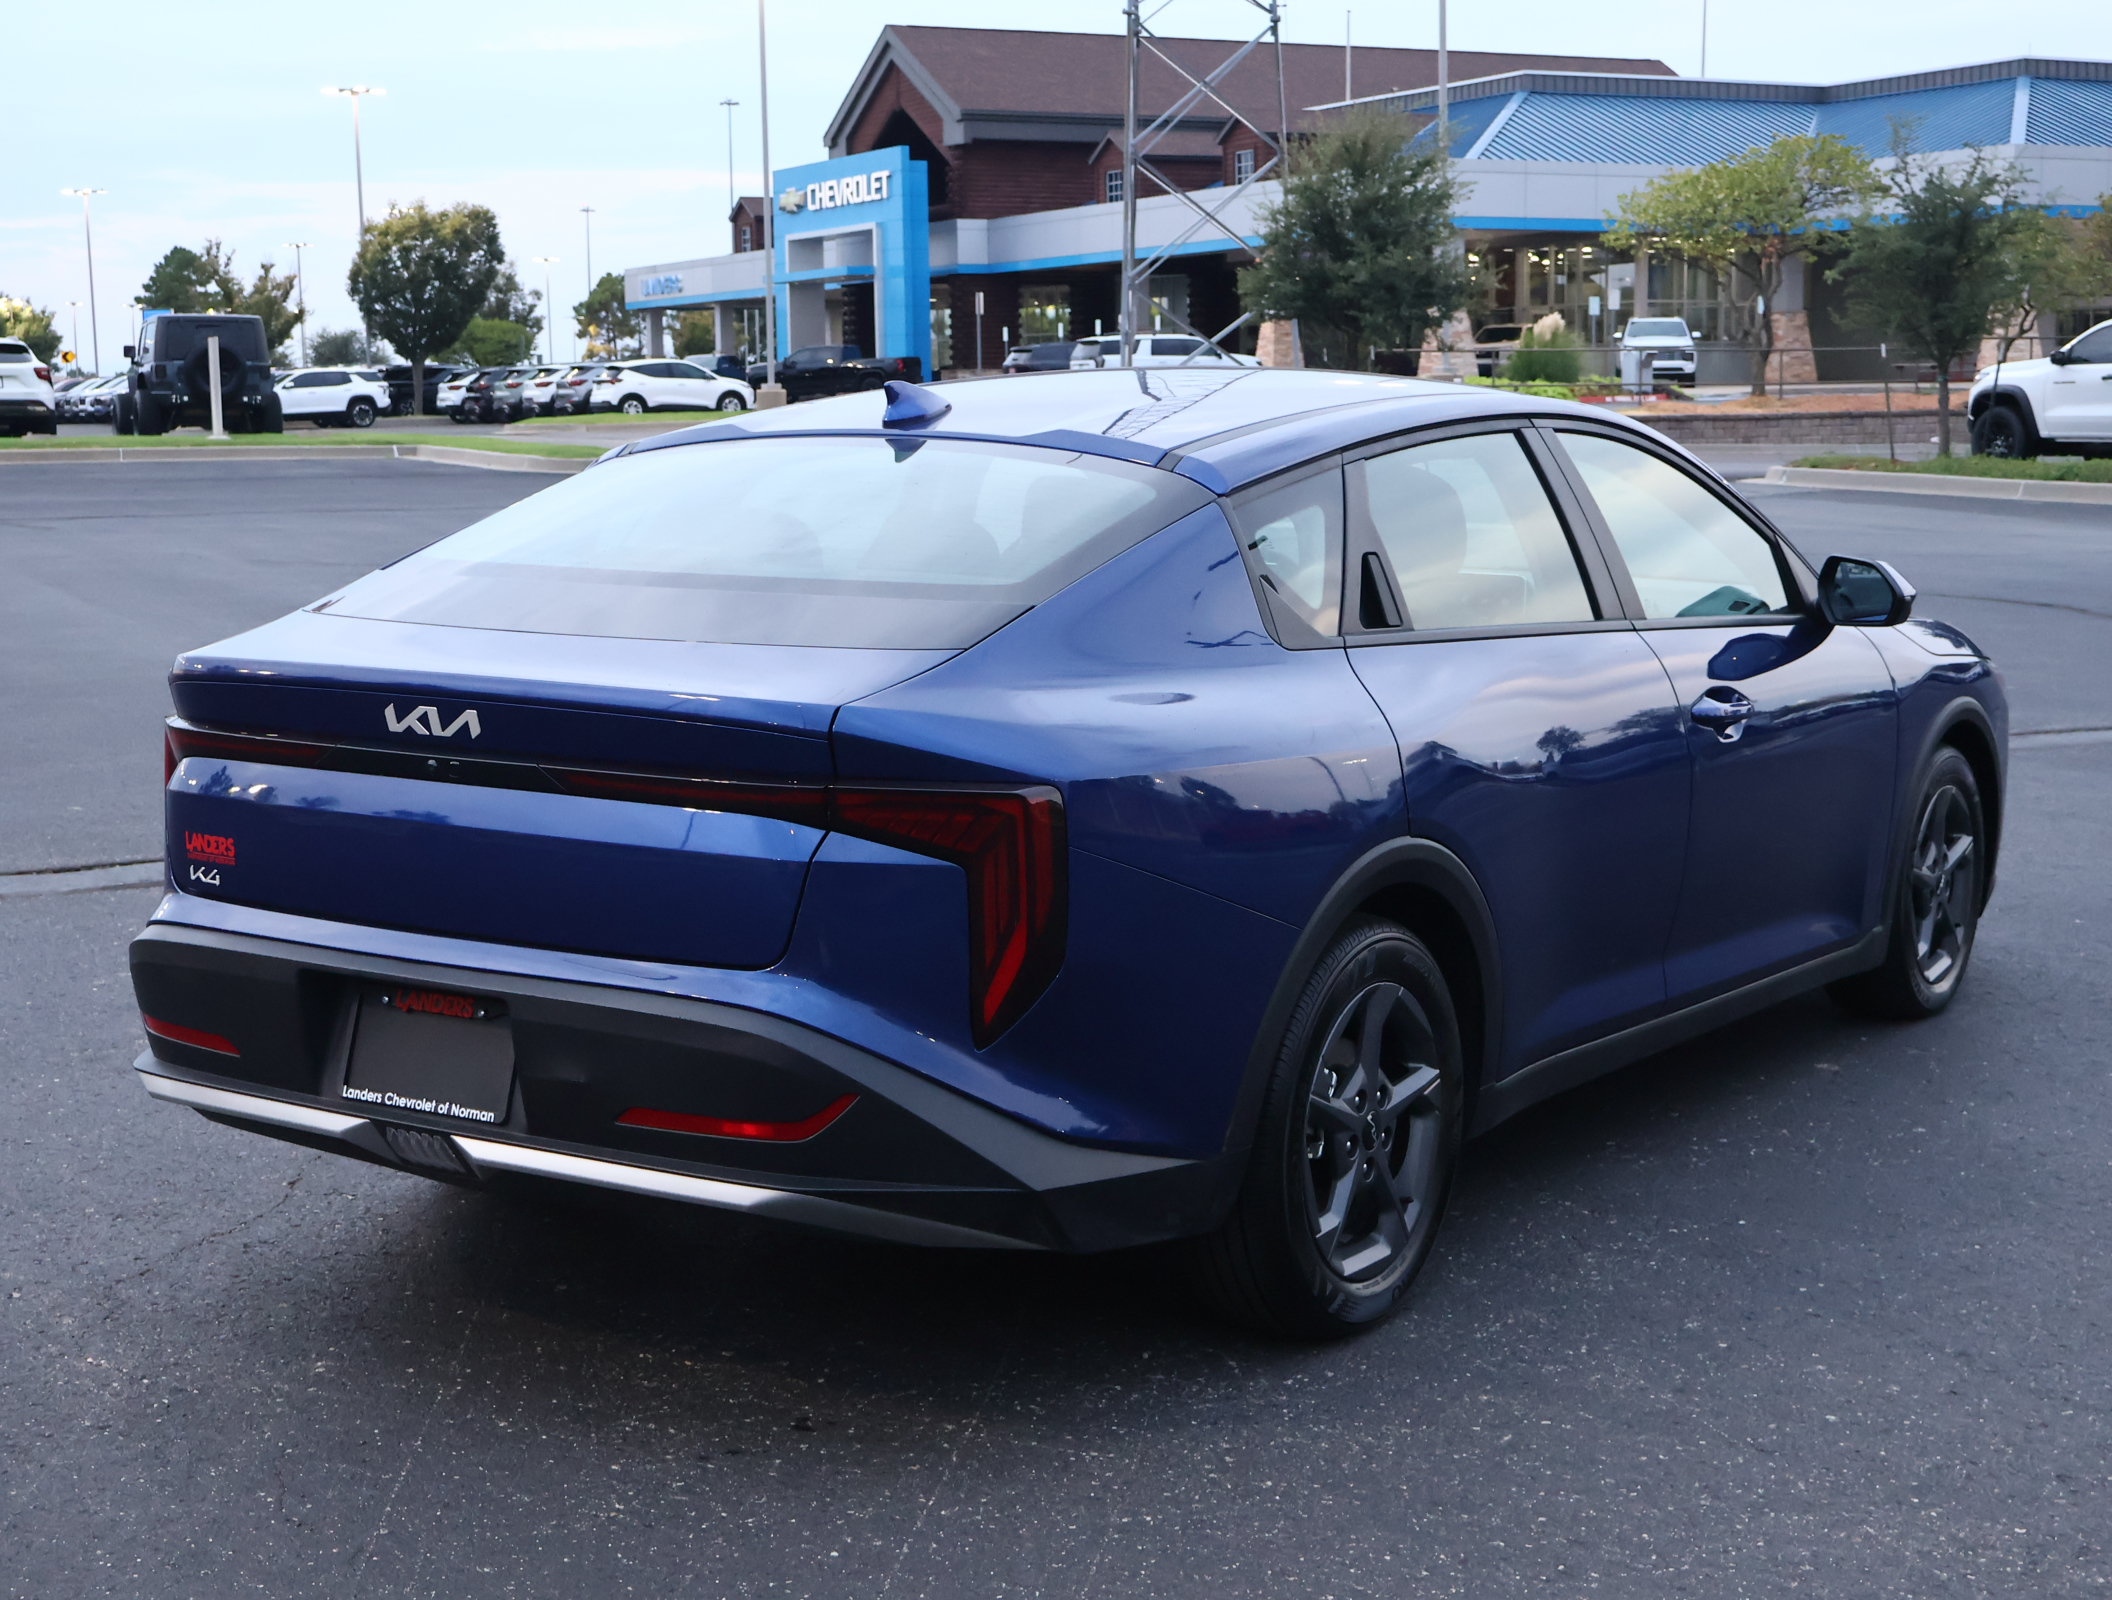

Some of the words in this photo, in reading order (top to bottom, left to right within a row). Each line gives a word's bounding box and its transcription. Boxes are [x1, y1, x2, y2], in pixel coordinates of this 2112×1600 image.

[806, 169, 892, 211] CHEVROLET
[384, 702, 481, 740] KIA
[185, 830, 236, 857] LANDERS
[189, 864, 220, 887] K4
[395, 989, 476, 1018] LANDERS
[342, 1084, 382, 1104] Landers
[384, 1092, 436, 1113] Chevrolet
[437, 1101, 450, 1115] of
[450, 1103, 495, 1123] Norman
